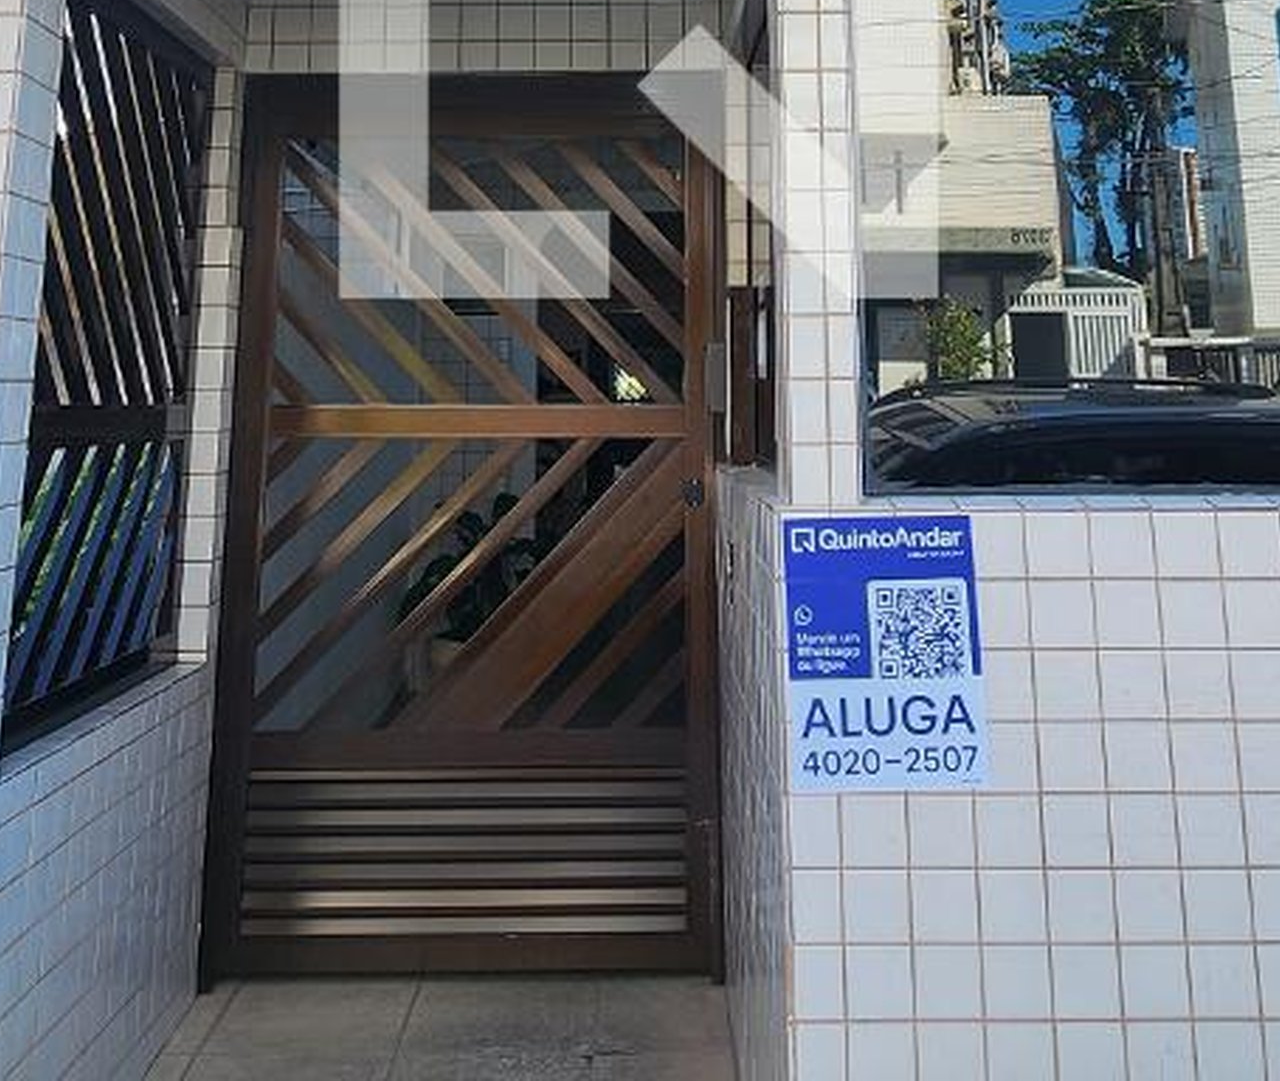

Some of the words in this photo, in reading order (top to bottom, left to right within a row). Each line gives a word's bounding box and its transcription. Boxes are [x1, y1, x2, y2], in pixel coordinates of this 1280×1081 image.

[819, 526, 964, 551] QuintoAndar
[801, 694, 977, 739] ALUGA
[802, 745, 979, 778] 4020-2507
